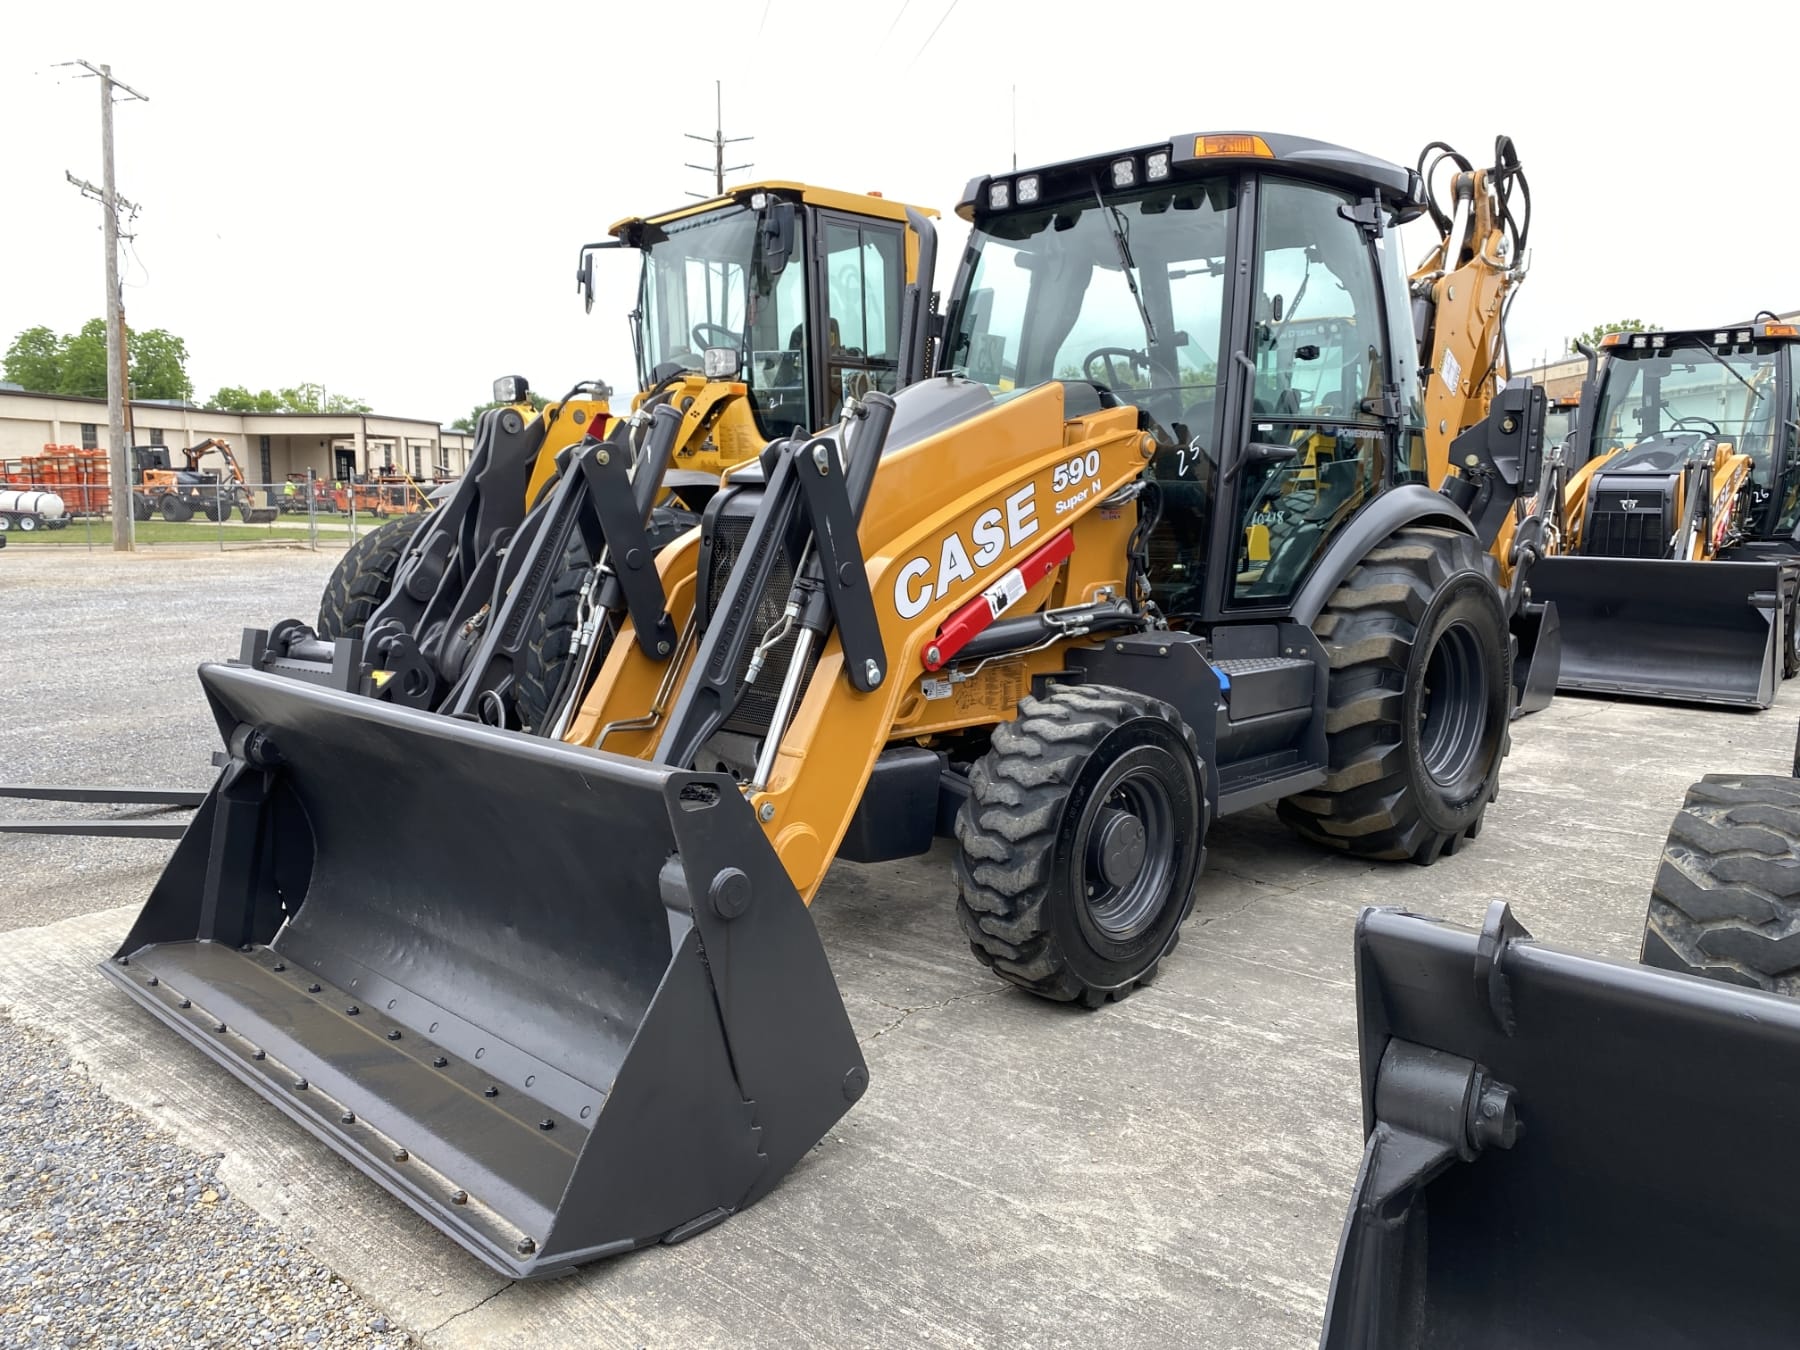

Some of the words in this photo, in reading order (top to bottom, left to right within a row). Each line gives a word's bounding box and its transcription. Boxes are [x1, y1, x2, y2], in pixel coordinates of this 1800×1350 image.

[769, 393, 783, 409] 21
[1052, 448, 1101, 493] 590
[1176, 435, 1200, 477] 25
[1055, 488, 1089, 514] Super
[1092, 478, 1102, 495] N
[1753, 489, 1770, 503] 26
[894, 480, 1039, 620] CASE
